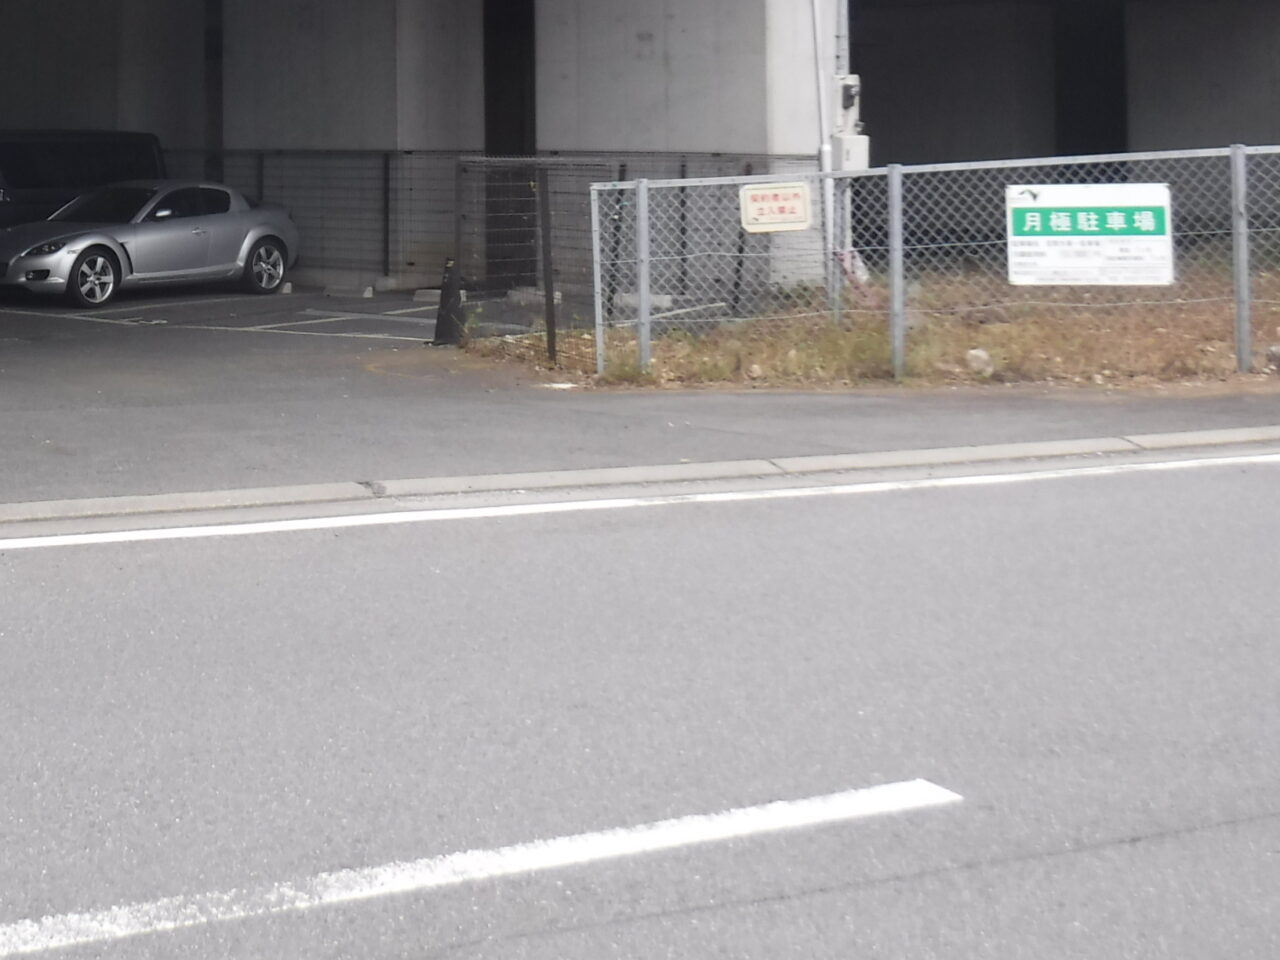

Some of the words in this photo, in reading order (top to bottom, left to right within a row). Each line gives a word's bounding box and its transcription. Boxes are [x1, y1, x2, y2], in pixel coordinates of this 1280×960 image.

[1023, 211, 1156, 231] 月極駐車場
